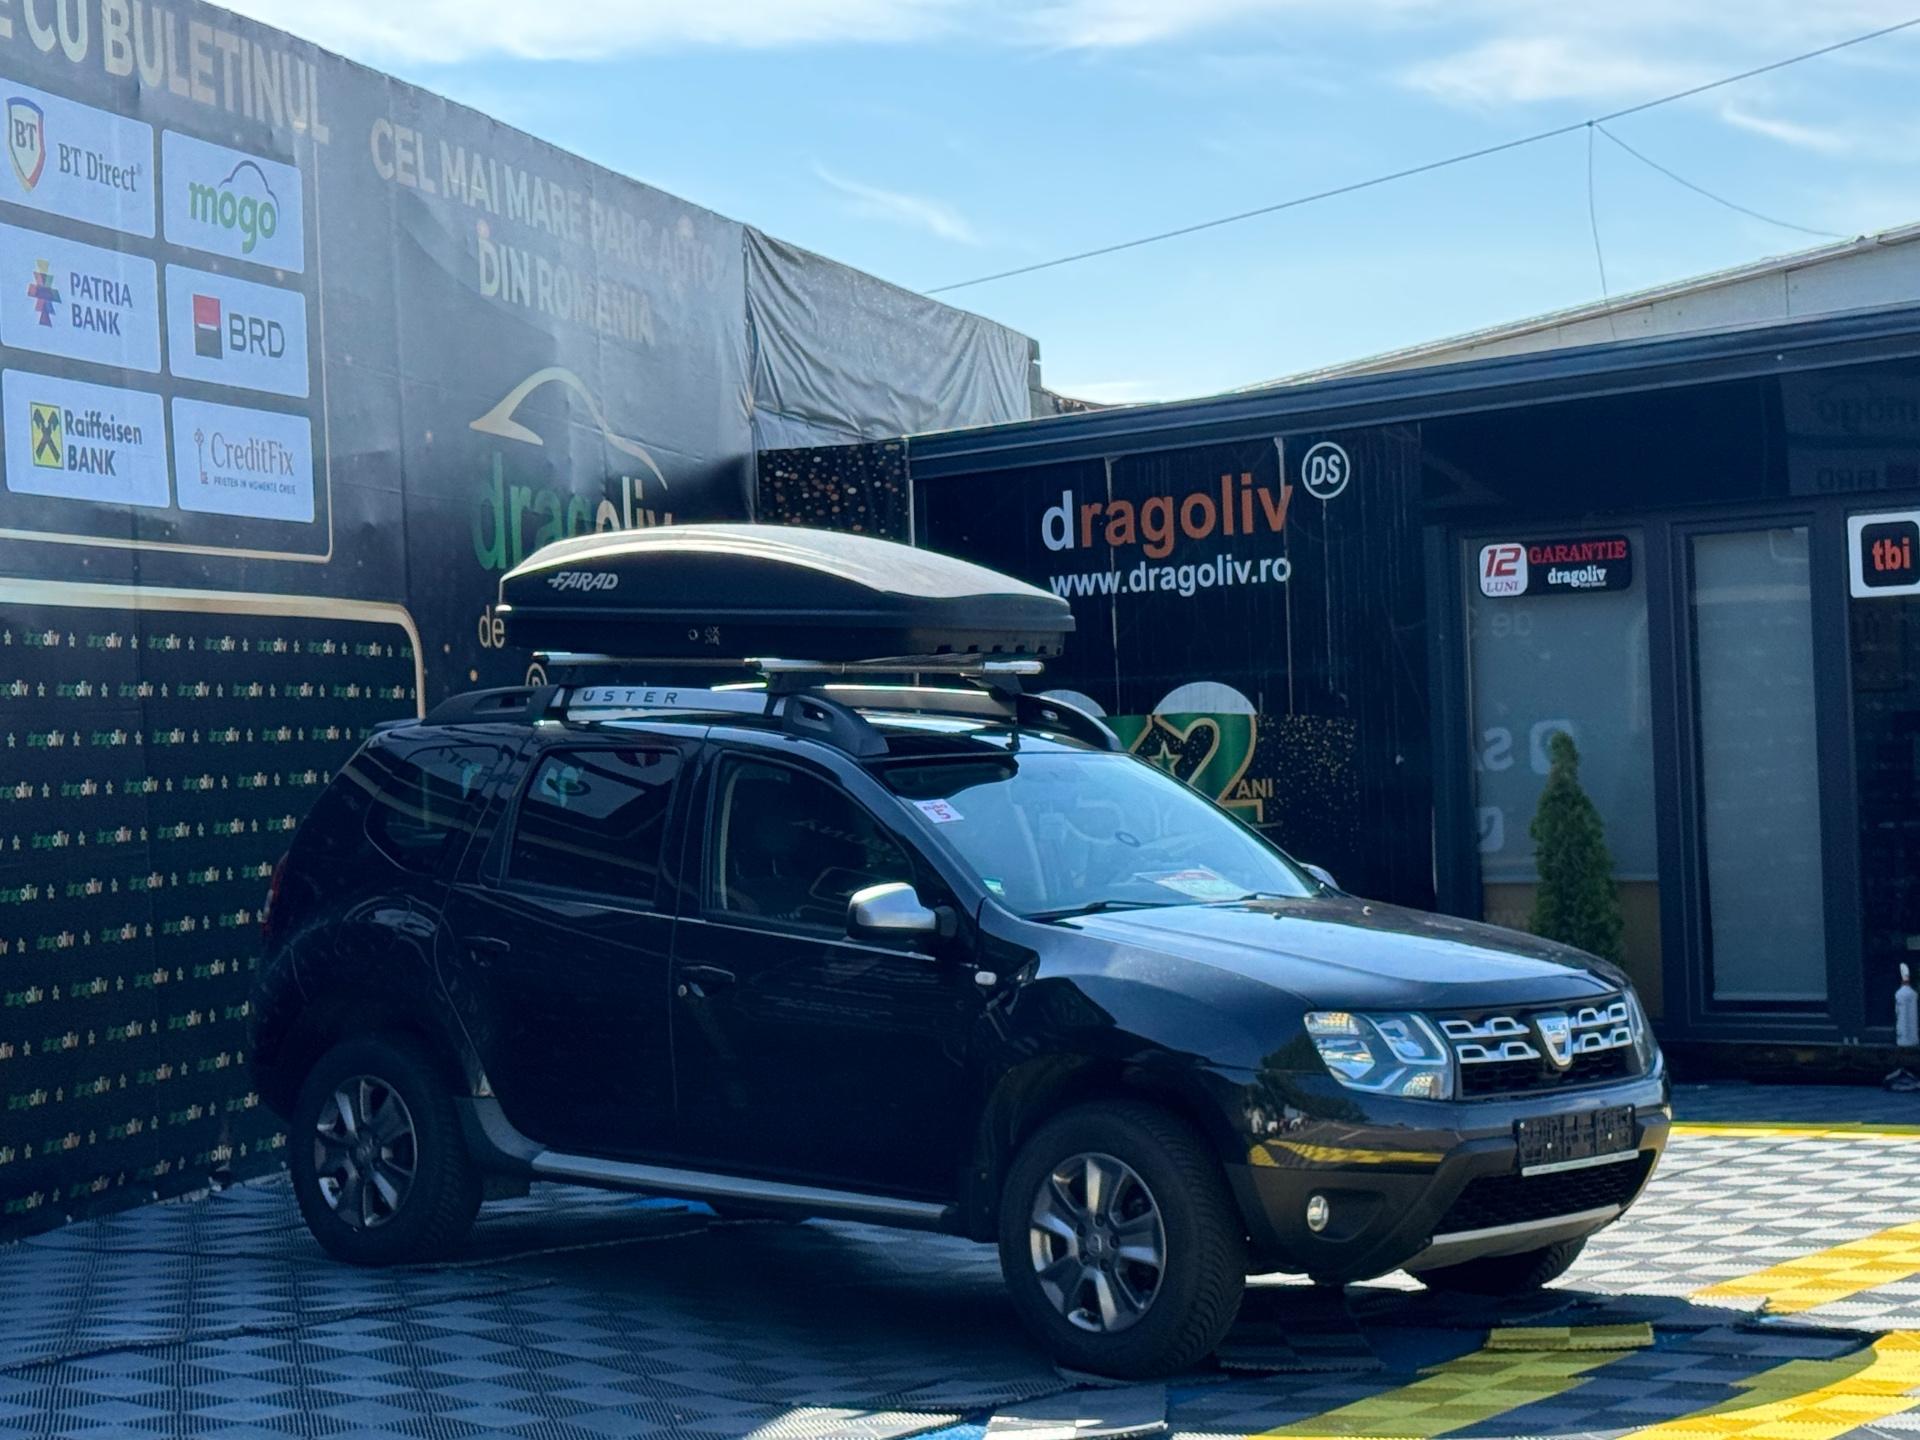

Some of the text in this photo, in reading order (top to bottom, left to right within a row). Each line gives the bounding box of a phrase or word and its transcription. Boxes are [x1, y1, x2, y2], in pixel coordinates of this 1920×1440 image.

[24, 0, 330, 145] CU BULETINUL
[14, 119, 36, 151] BT
[58, 143, 137, 192] BT Direct
[370, 118, 437, 194] CEL
[440, 140, 500, 215] MAI
[504, 165, 583, 241] MARE
[188, 181, 277, 254] mogo
[70, 271, 134, 308] PATRIA
[478, 236, 531, 307] DIN
[71, 302, 121, 337] BANK
[228, 313, 286, 359] BRD
[64, 408, 143, 446] Raiffeisen
[67, 445, 117, 477] BANK
[210, 431, 295, 477] CreditFix
[1311, 453, 1342, 486] DS
[1041, 472, 1294, 558] dragoliv
[1485, 540, 1627, 578] 12 GARANTIE
[1871, 536, 1912, 572] tbi
[547, 572, 619, 591] FARAD
[1050, 554, 1292, 598] www.dragoliv.ro
[1486, 581, 1519, 593] LUNI
[1547, 565, 1608, 587] dragoliv
[1237, 778, 1274, 798] ANI
